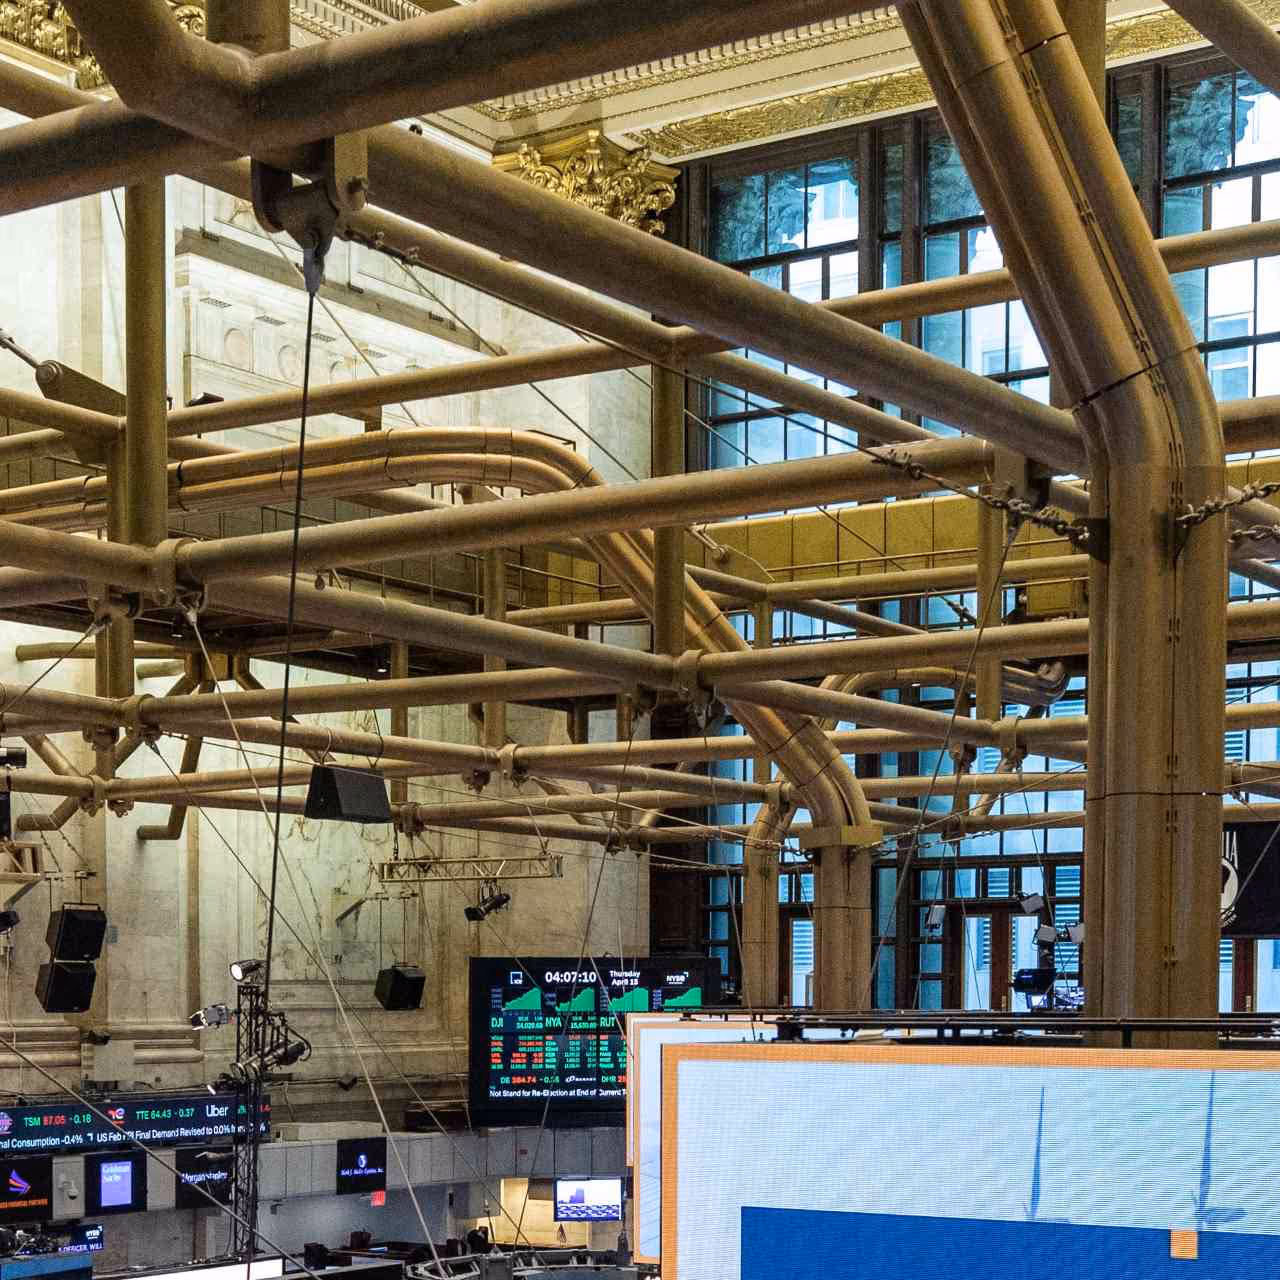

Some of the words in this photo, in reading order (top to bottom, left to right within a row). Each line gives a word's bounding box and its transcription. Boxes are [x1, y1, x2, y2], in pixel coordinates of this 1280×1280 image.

[545, 971, 597, 983] 04:07:10
[610, 970, 640, 980] Thursday
[491, 1017, 503, 1028] DJI
[545, 1017, 561, 1027] NYA
[600, 1017, 615, 1027] RUT
[577, 1089, 589, 1097] End
[24, 1117, 41, 1127] TSM
[205, 1104, 229, 1117] Uber
[11, 1136, 60, 1149] Consumption
[61, 1134, 83, 1145] -0.4%
[97, 1132, 108, 1142] US
[108, 1131, 121, 1141] Feb
[135, 1130, 151, 1139] Final
[152, 1128, 179, 1139] Demand
[179, 1127, 205, 1137] Revised
